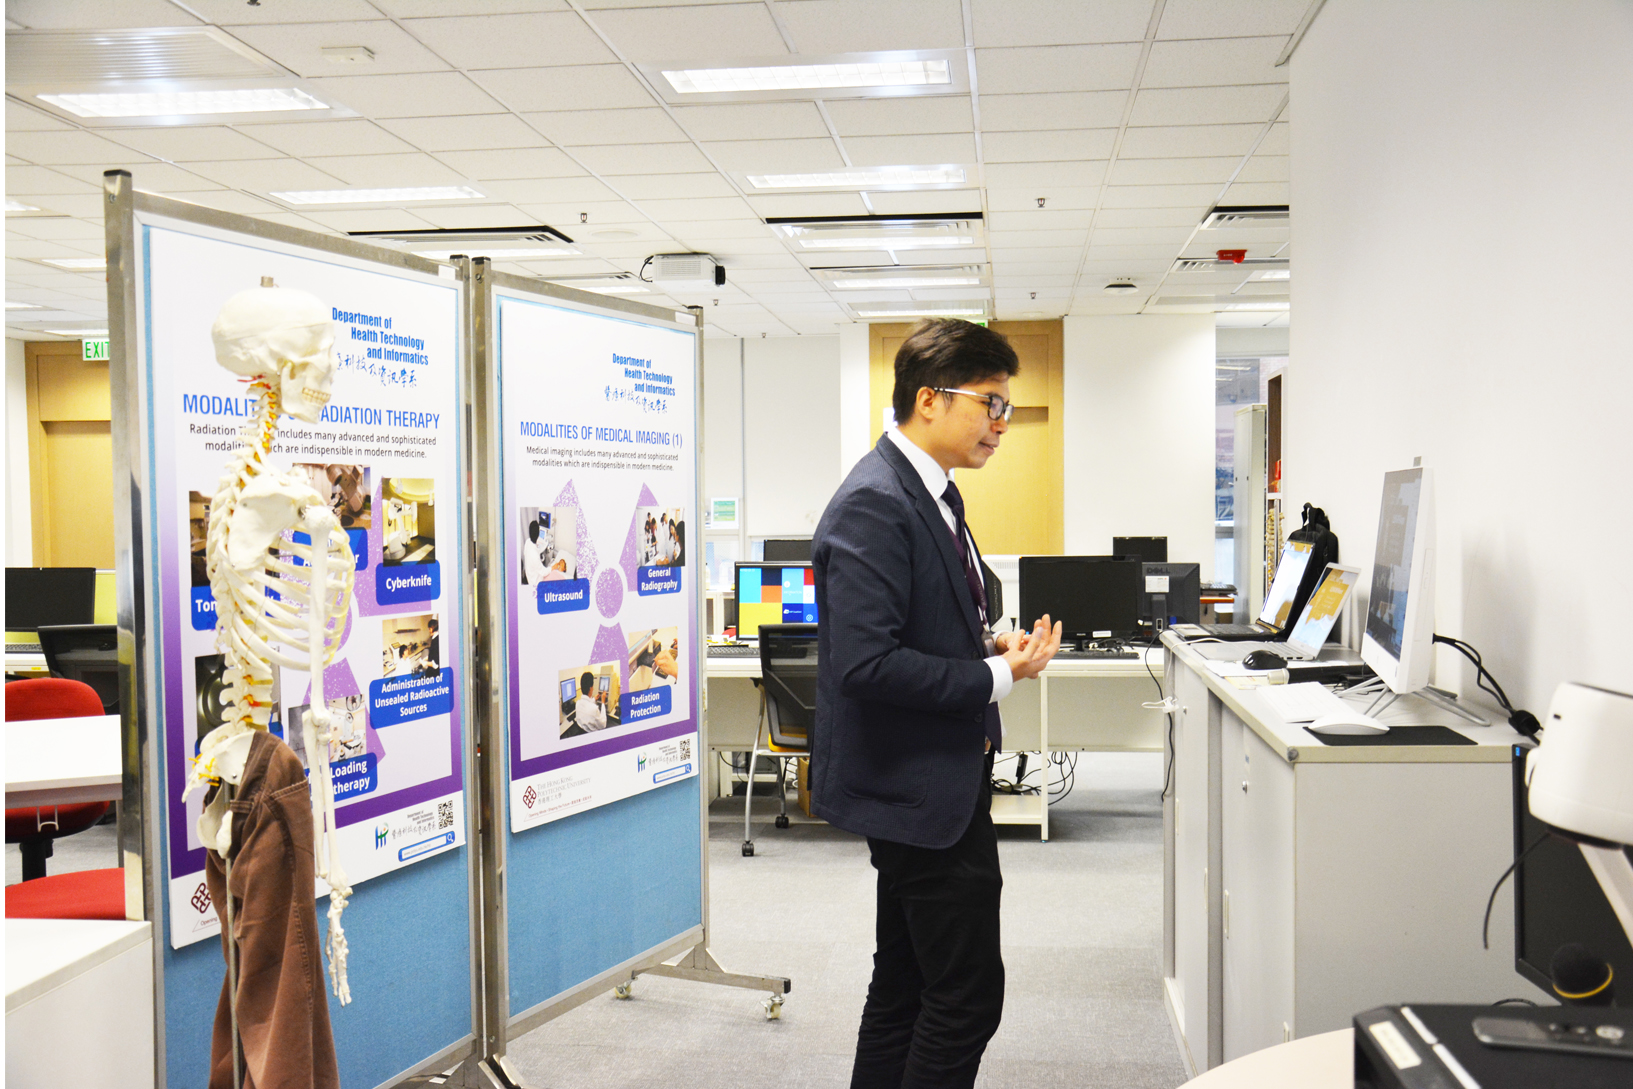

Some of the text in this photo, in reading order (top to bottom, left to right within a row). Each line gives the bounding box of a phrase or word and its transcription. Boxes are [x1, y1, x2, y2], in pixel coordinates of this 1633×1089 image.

[331, 306, 392, 329] Department of
[351, 326, 425, 351] Health Technology
[366, 347, 429, 365] and Informatics
[612, 352, 652, 369] Department of
[625, 367, 673, 385] Health Technology
[635, 382, 676, 396] and Informatics
[183, 393, 440, 429] MODALIT ADIATION THERAPY
[189, 423, 236, 436] Radiation
[277, 428, 313, 440] includes
[314, 431, 337, 443] many
[338, 431, 375, 443] advanced
[376, 433, 390, 444] and
[391, 435, 437, 446] sophisticated
[520, 421, 683, 449] MODALITIES OF MEDICAL IMAGING (1)
[285, 445, 300, 454] are
[301, 444, 353, 457] indispensible
[354, 446, 363, 456] in
[364, 447, 392, 457] modern
[394, 448, 428, 459] medicine.
[526, 446, 679, 462] Medical imaging includes many advanced and sophisticated
[532, 458, 675, 472] modalities which are indispensible in modern medicine.
[647, 567, 671, 579] General
[386, 574, 432, 592] Cyberknife
[641, 579, 679, 592] Radiography
[544, 589, 583, 603] Ultrasound
[381, 672, 444, 694] Administration of
[374, 685, 450, 709] Unsealed Radioactive
[631, 692, 660, 706] Radiation
[399, 703, 428, 717] Sources
[630, 704, 662, 719] Protection
[330, 760, 368, 779] Loading
